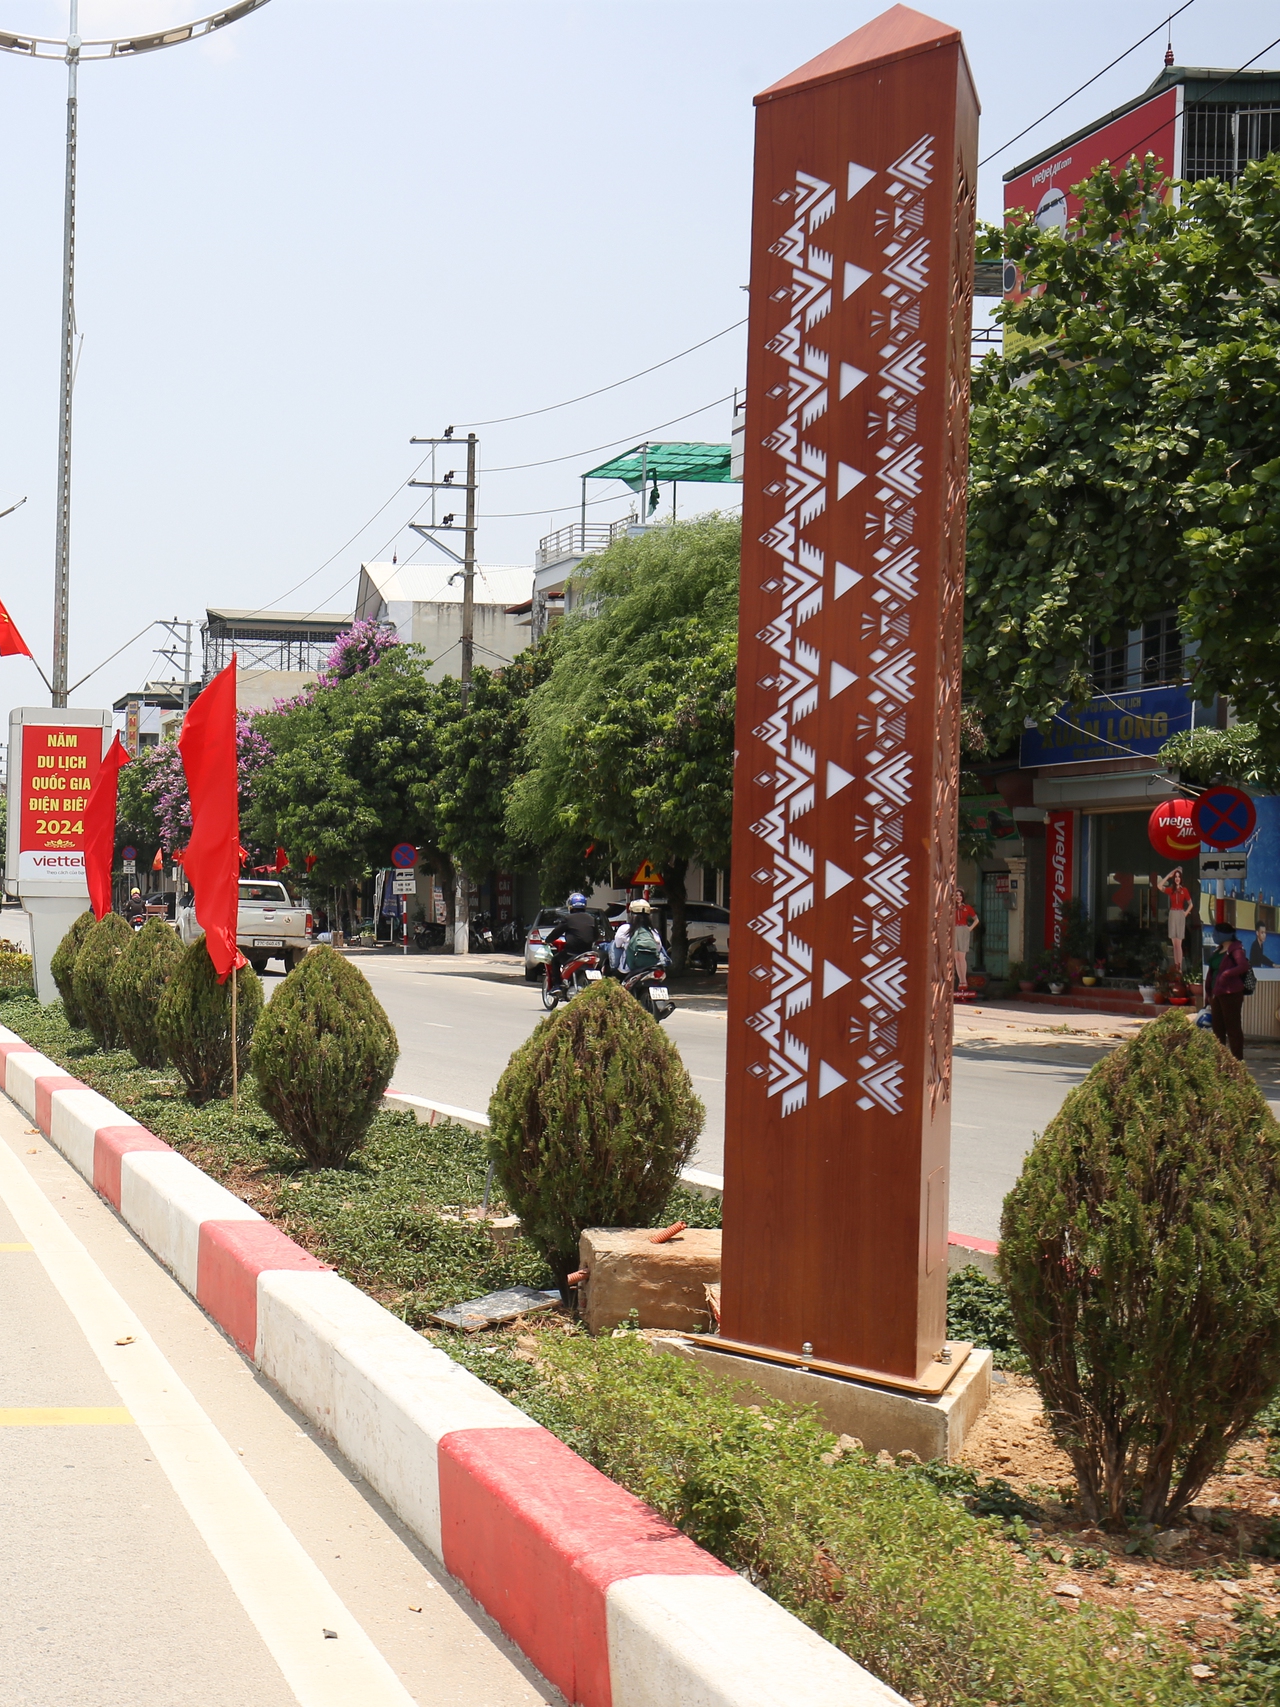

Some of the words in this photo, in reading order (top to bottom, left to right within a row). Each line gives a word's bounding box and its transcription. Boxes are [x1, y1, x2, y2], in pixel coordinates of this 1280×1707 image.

[1127, 696, 1142, 710] LỊCH
[1041, 719, 1099, 749] XUÂN
[1107, 712, 1168, 741] LONG
[47, 732, 77, 747] NĂM
[37, 756, 55, 768] DU
[58, 756, 87, 771] LỊCH
[31, 772, 66, 791] QUỐC
[69, 778, 91, 790] GIA
[29, 795, 59, 813] ĐIỆN
[35, 820, 84, 834] 2024
[32, 855, 85, 867] viettel
